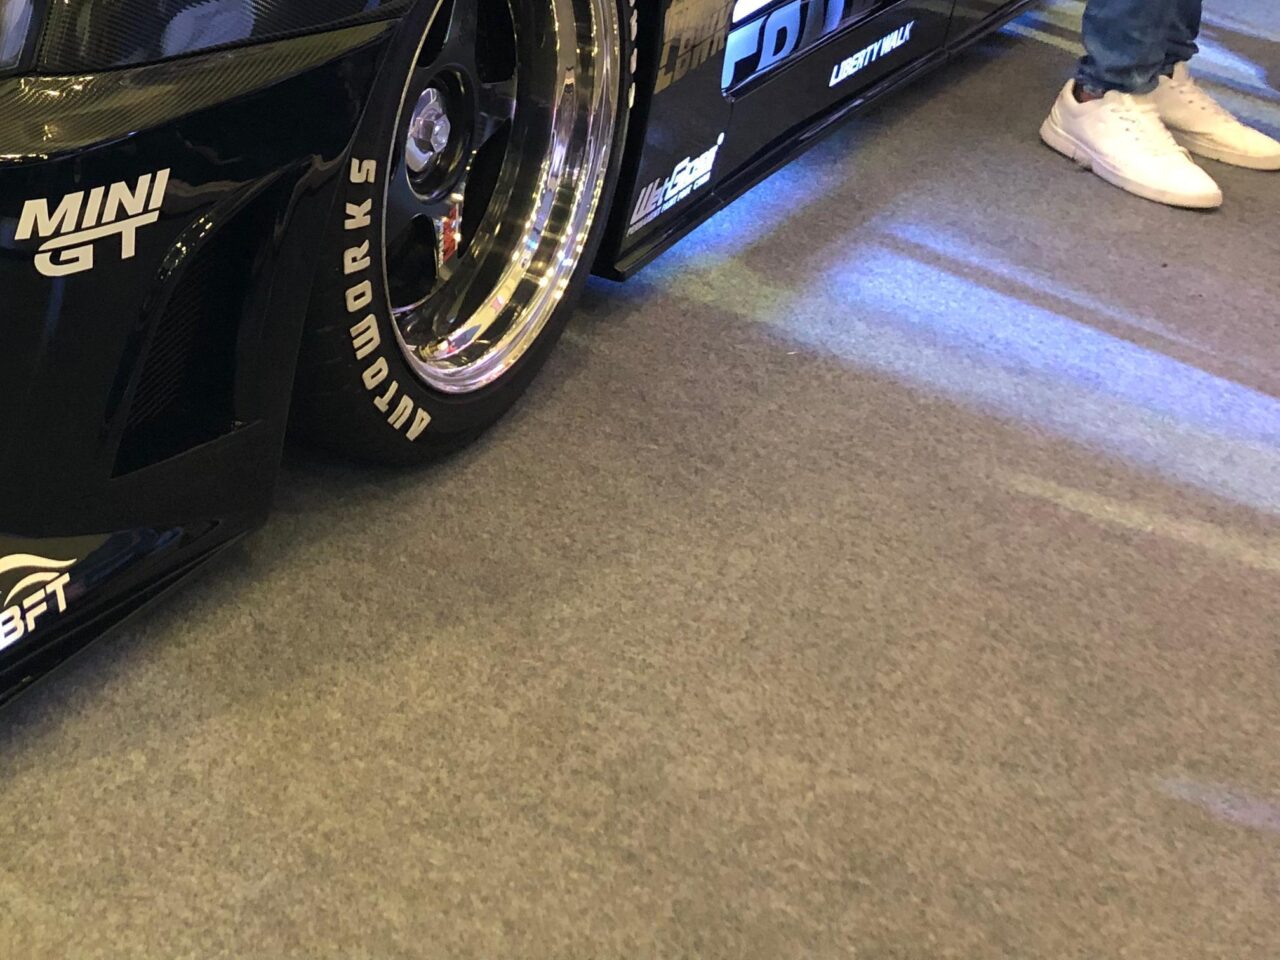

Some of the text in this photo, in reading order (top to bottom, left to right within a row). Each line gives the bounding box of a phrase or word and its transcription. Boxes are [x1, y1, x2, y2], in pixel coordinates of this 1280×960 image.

[828, 20, 915, 88] LIBERTY WALK
[14, 167, 171, 241] MINI
[33, 210, 160, 278] GT
[343, 157, 432, 442] AUTOWORKS
